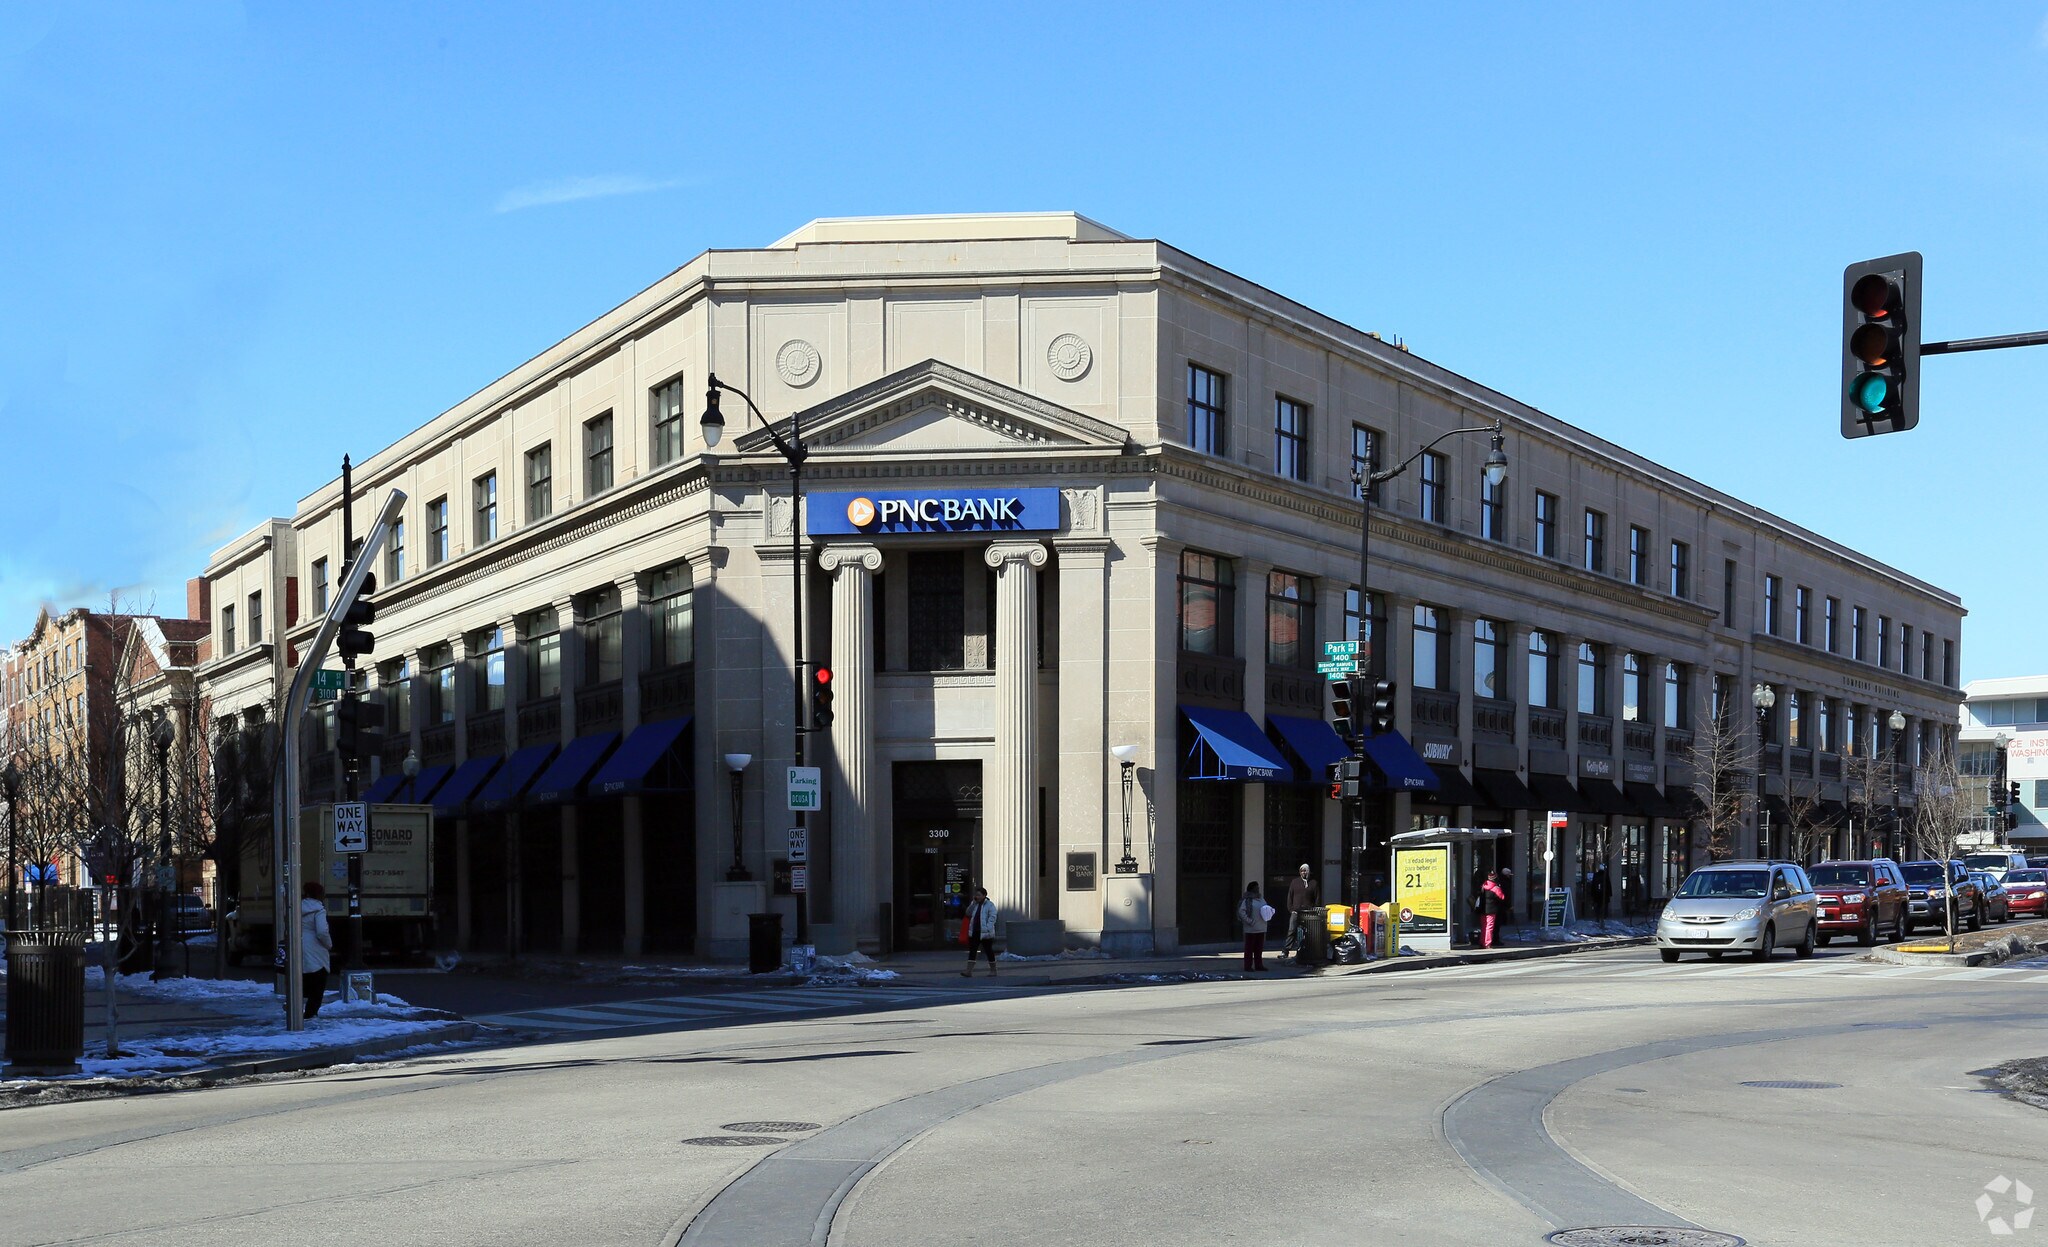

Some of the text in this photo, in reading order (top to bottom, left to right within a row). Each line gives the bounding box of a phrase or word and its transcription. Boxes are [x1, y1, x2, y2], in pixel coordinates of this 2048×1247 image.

[878, 497, 1018, 523] PNC BANK
[1328, 644, 1346, 653] Park
[317, 671, 327, 686] 14
[318, 688, 336, 699] 3100
[1423, 742, 1453, 760] SUBWAY
[790, 770, 817, 785] Parking
[337, 806, 361, 819] ONE
[337, 820, 363, 832] WAY
[370, 828, 412, 841] EONARD
[790, 830, 805, 839] ONE
[928, 829, 949, 838] 3300
[790, 840, 805, 849] WAY
[1425, 857, 1438, 865] legal
[1075, 870, 1093, 878] BANK
[1405, 873, 1422, 888] 21
